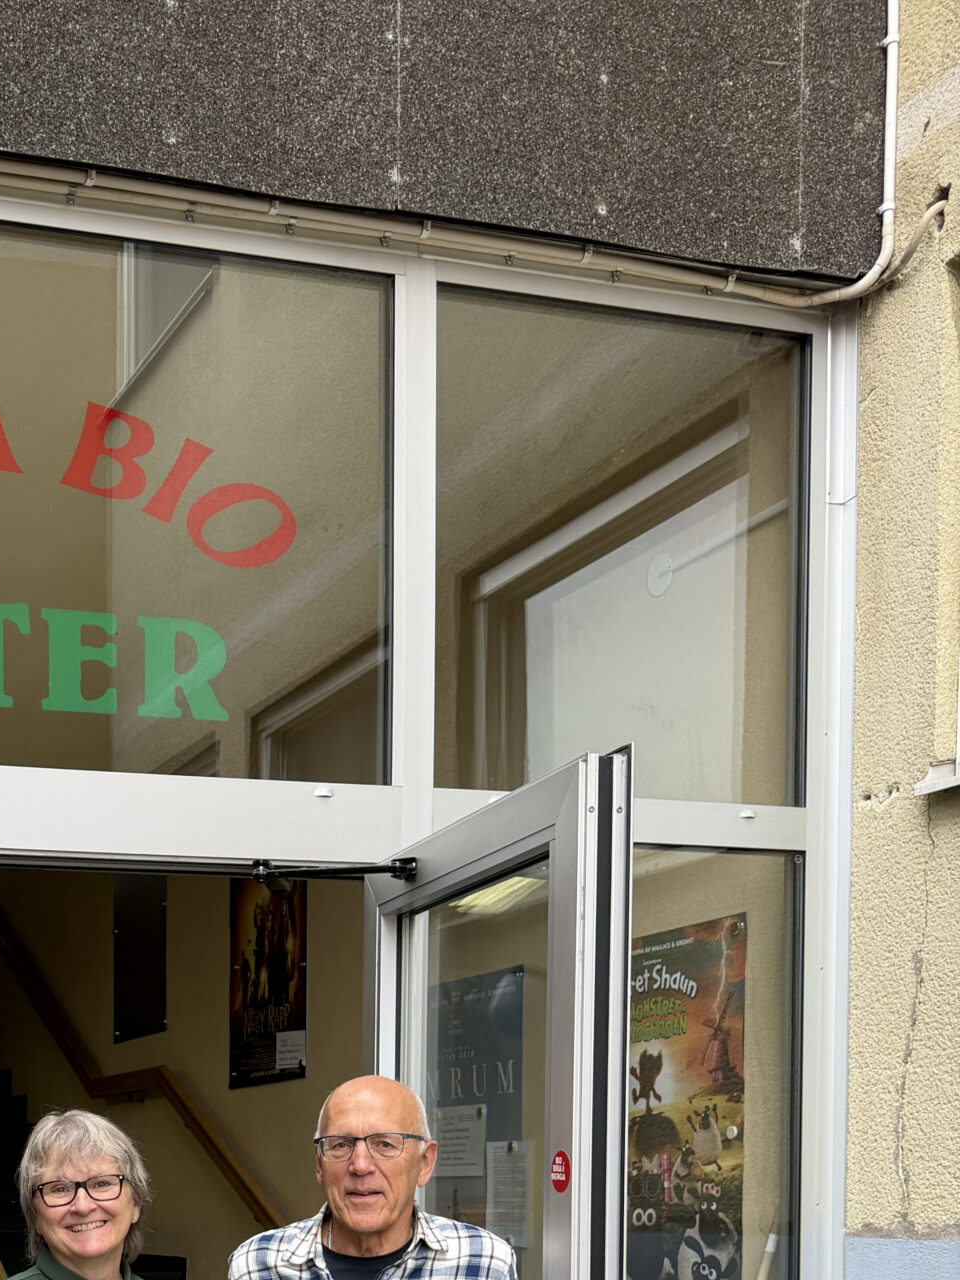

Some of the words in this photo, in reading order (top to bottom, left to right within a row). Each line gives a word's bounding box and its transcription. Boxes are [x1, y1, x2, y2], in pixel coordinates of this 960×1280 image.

[60, 401, 297, 568] BIO
[631, 968, 650, 993] et
[652, 964, 698, 998] Shaun
[266, 1003, 291, 1033] RAPP
[552, 1164, 562, 1172] BRA
[555, 1156, 562, 1164] BO
[551, 1172, 566, 1181] BERGA
